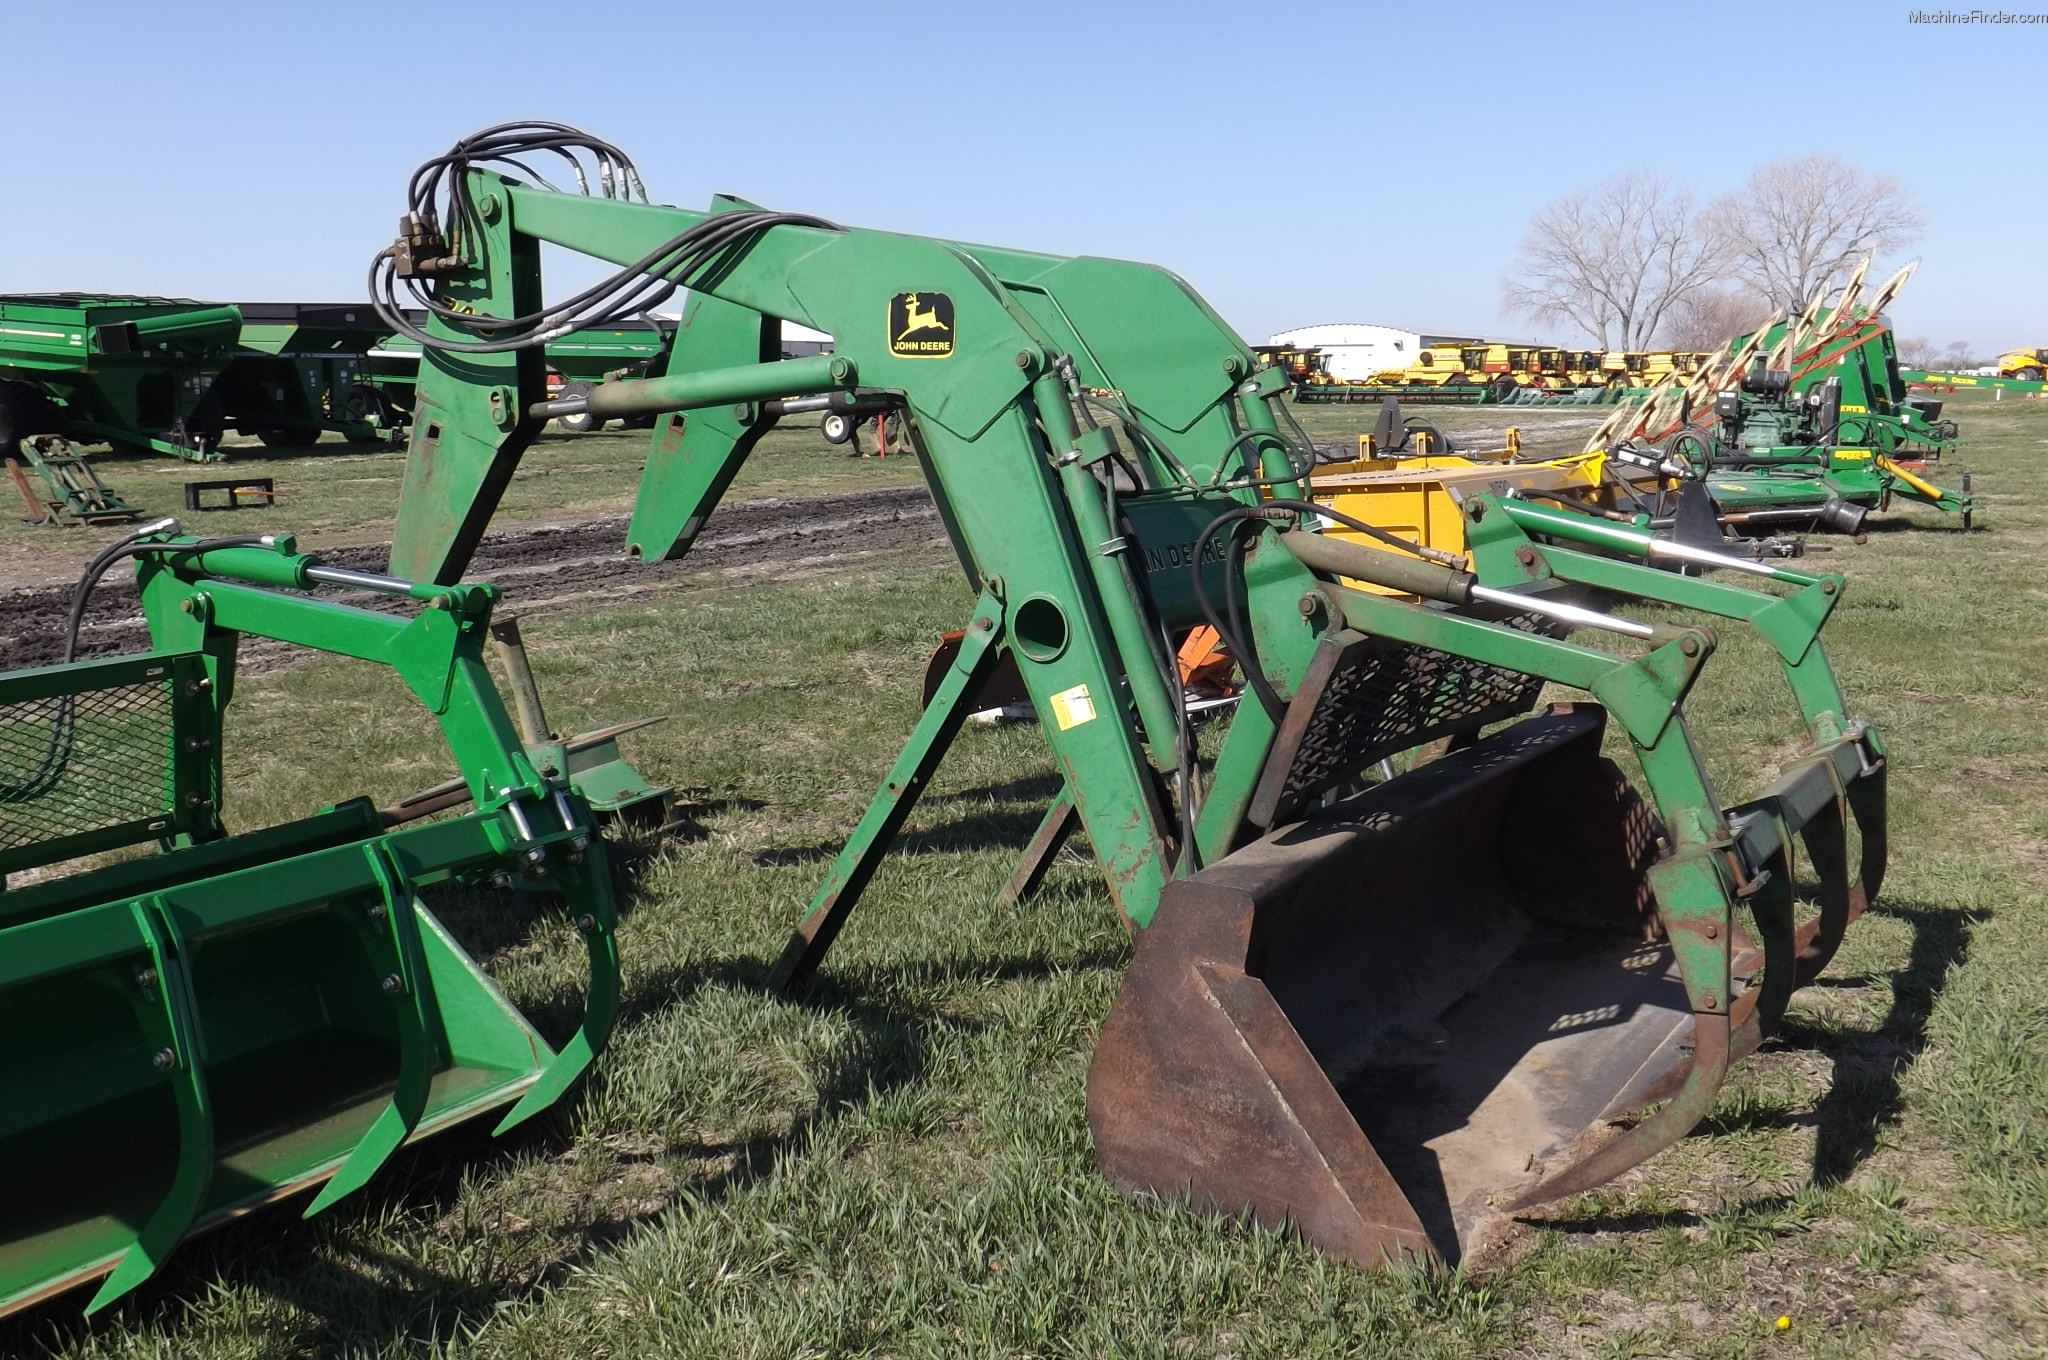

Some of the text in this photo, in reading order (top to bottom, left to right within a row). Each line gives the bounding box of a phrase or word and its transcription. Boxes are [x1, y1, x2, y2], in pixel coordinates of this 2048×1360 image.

[893, 341, 951, 351] JOHN DEERE
[1925, 375, 1977, 386] JOHN DEERE
